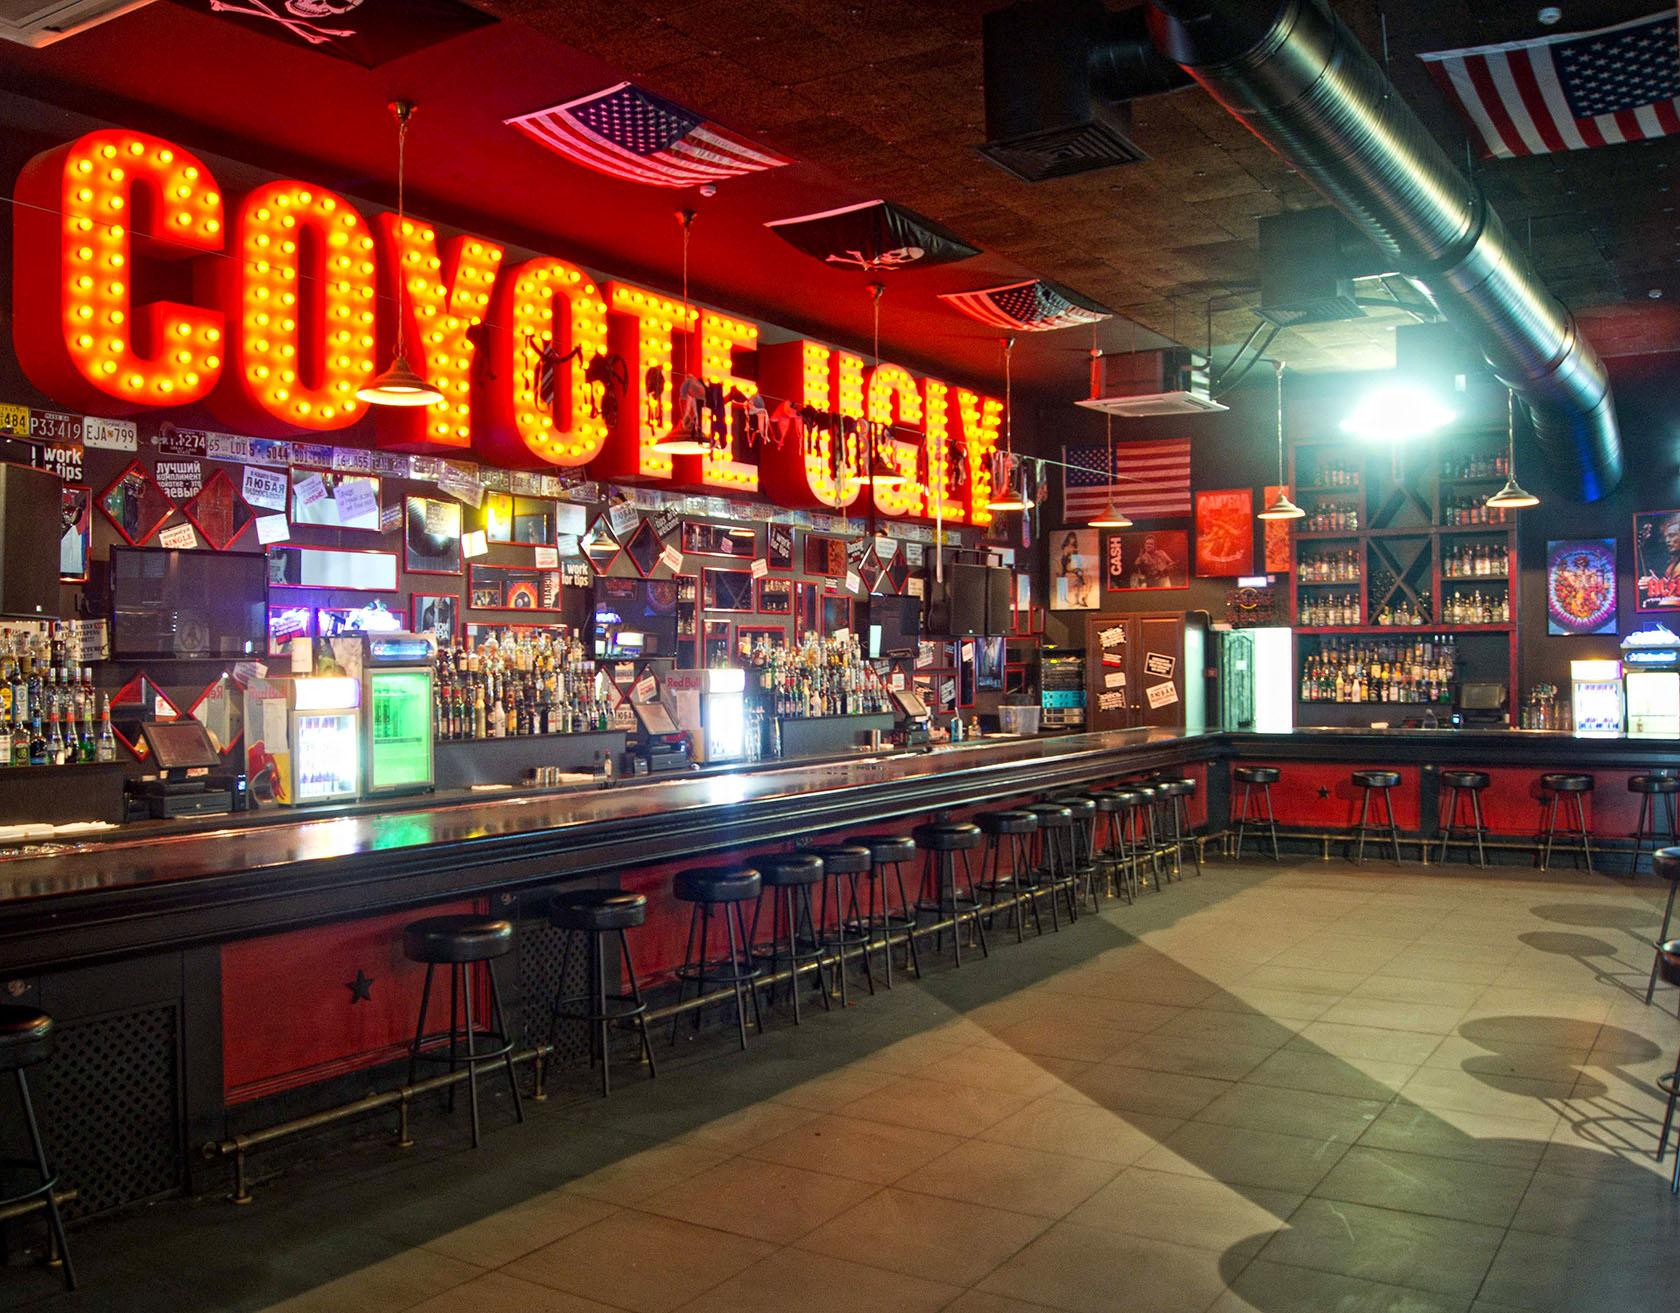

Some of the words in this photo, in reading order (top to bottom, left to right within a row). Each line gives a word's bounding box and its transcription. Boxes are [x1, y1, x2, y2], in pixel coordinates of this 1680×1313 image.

[62, 128, 759, 492] COYOTE
[802, 339, 1003, 526] UGLY
[86, 424, 107, 442] EJA
[114, 428, 134, 443] 799
[44, 447, 82, 465] work
[56, 462, 83, 481] tips
[245, 476, 285, 494] ЛЮБАЯ
[1110, 537, 1122, 576] CASH
[566, 563, 589, 575] work
[574, 574, 589, 588] tips
[667, 676, 684, 688] Red
[685, 676, 701, 688] Bull
